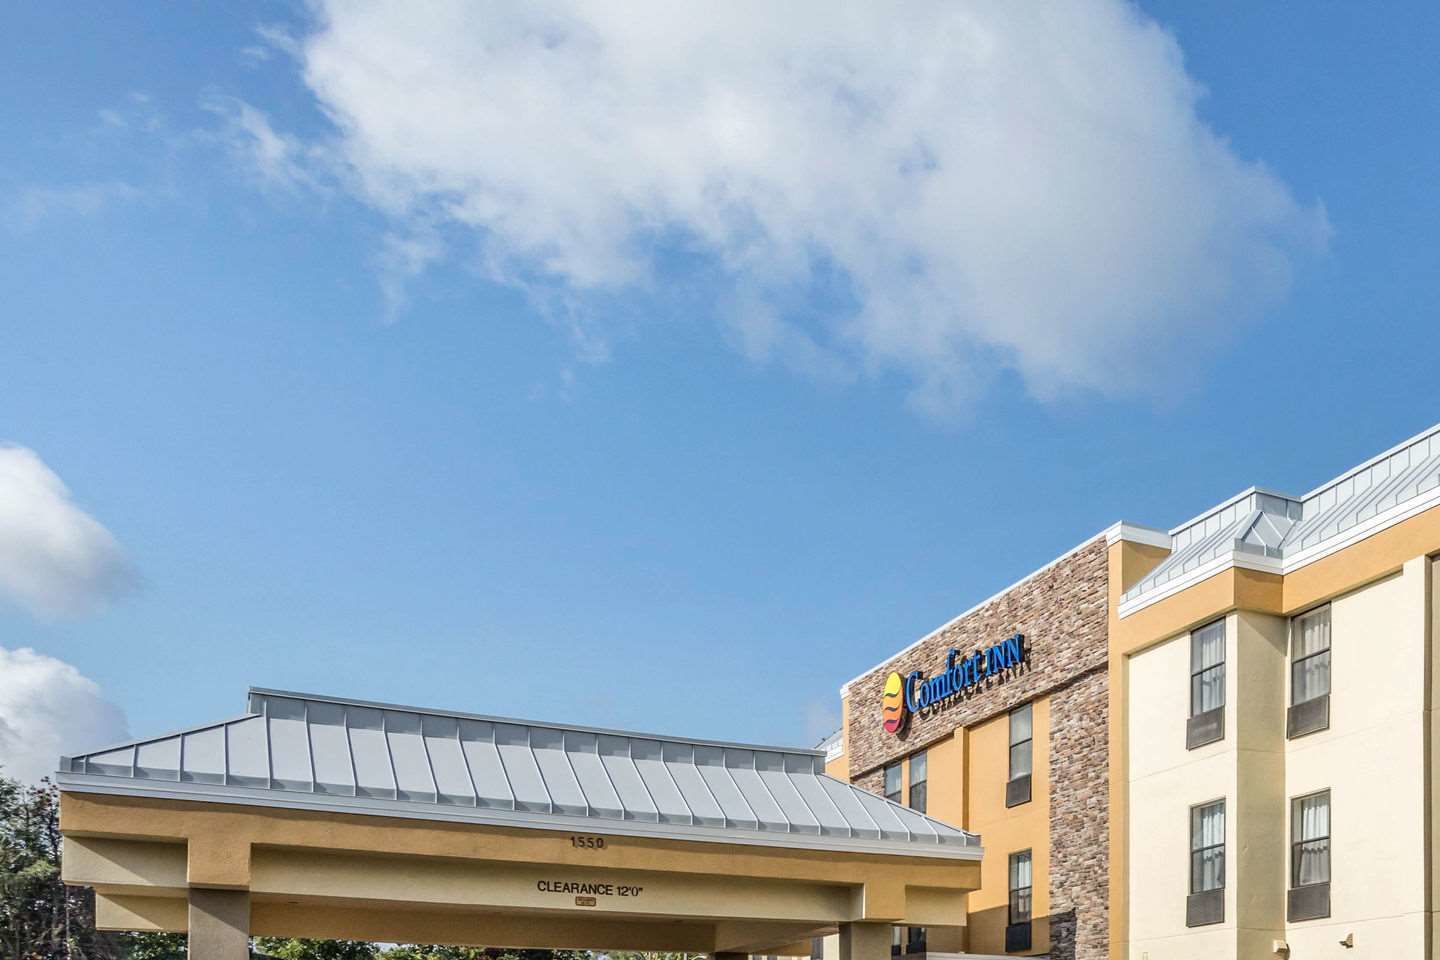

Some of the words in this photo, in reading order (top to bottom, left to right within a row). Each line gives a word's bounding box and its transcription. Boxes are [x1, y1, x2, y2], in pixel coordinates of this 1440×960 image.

[904, 647, 983, 714] Comfort
[984, 633, 1026, 676] INN
[570, 836, 605, 848] 1550
[537, 880, 613, 896] CLEARANCE
[617, 886, 643, 897] 12'0"
